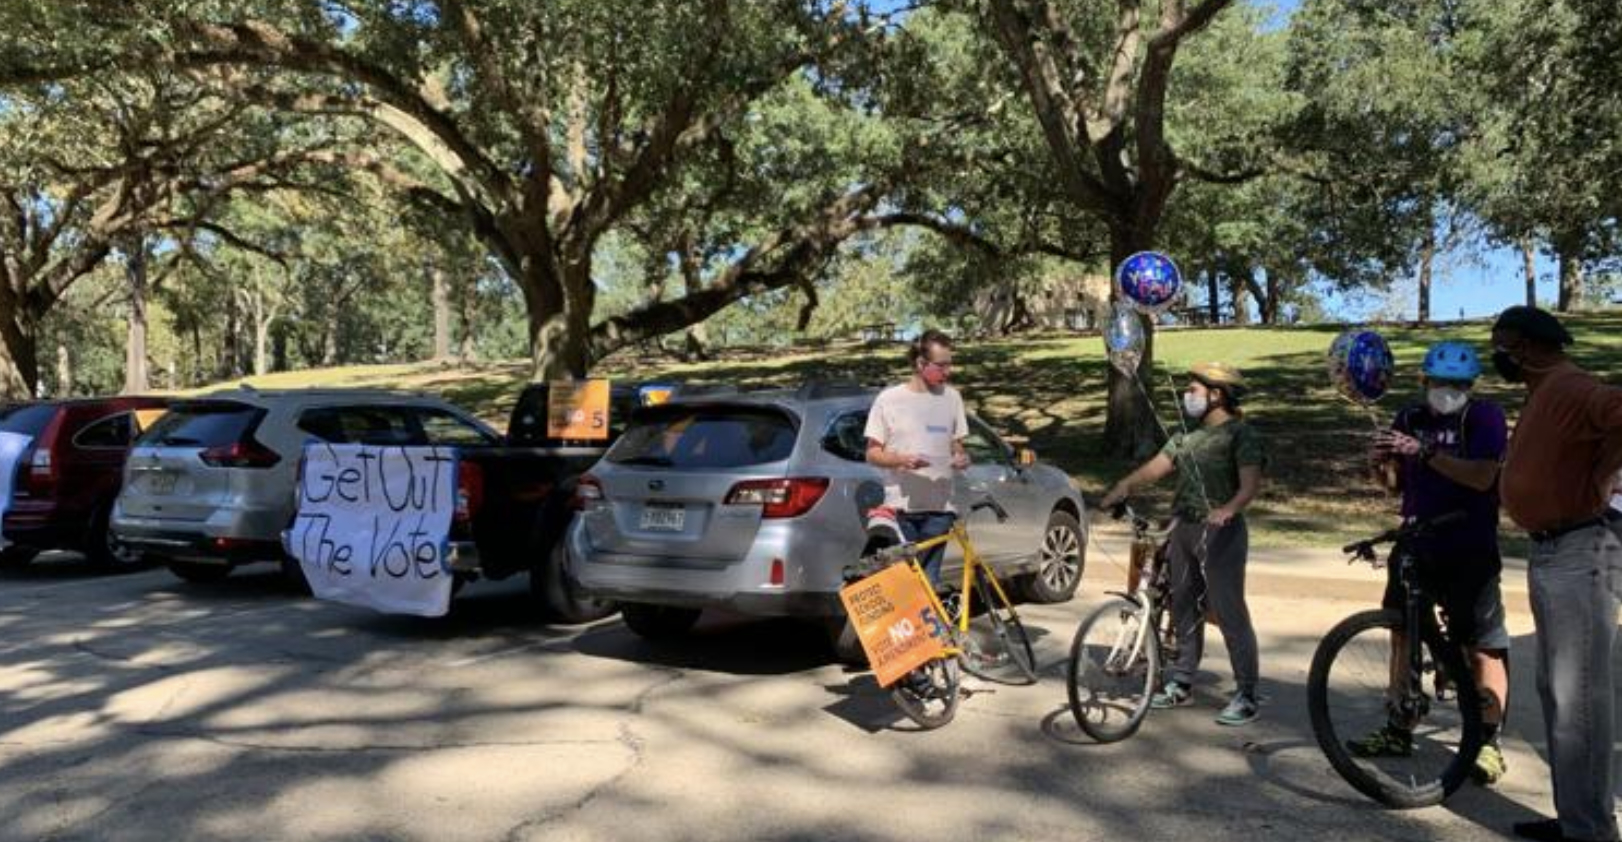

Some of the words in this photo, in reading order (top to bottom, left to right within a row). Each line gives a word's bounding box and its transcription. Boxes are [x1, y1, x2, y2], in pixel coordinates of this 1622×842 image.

[592, 411, 603, 428] 5
[304, 443, 376, 502] Get
[379, 444, 452, 512] Out
[300, 513, 352, 575] The
[370, 514, 439, 579] Vote
[888, 617, 915, 643] NO
[919, 605, 943, 638] 5
